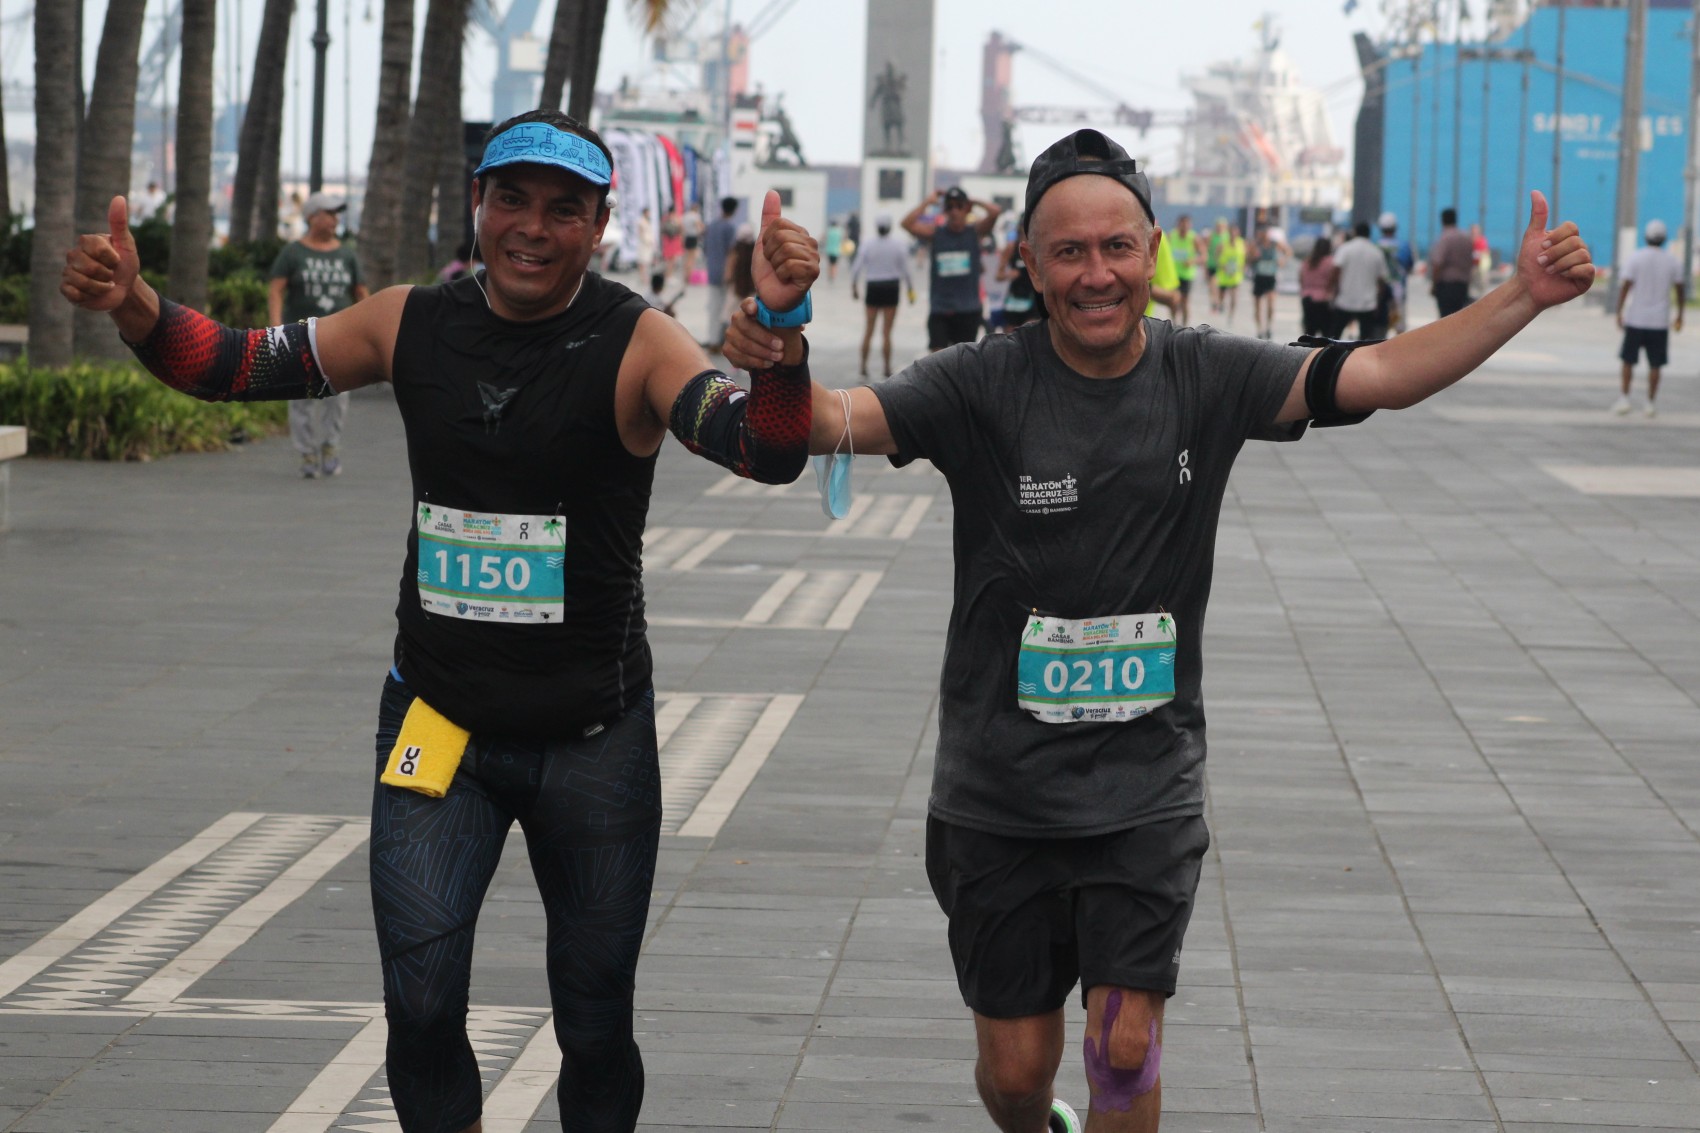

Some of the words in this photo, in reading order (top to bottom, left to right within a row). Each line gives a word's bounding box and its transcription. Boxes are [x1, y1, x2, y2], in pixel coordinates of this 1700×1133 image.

[1020, 490, 1062, 499] VERACRUZ
[437, 521, 452, 529] CASAS
[435, 550, 531, 591] 1150
[468, 604, 494, 612] Veracruz
[1047, 637, 1074, 645] BAMBINO
[1043, 656, 1145, 693] 0210
[1085, 707, 1111, 715] Veracruz
